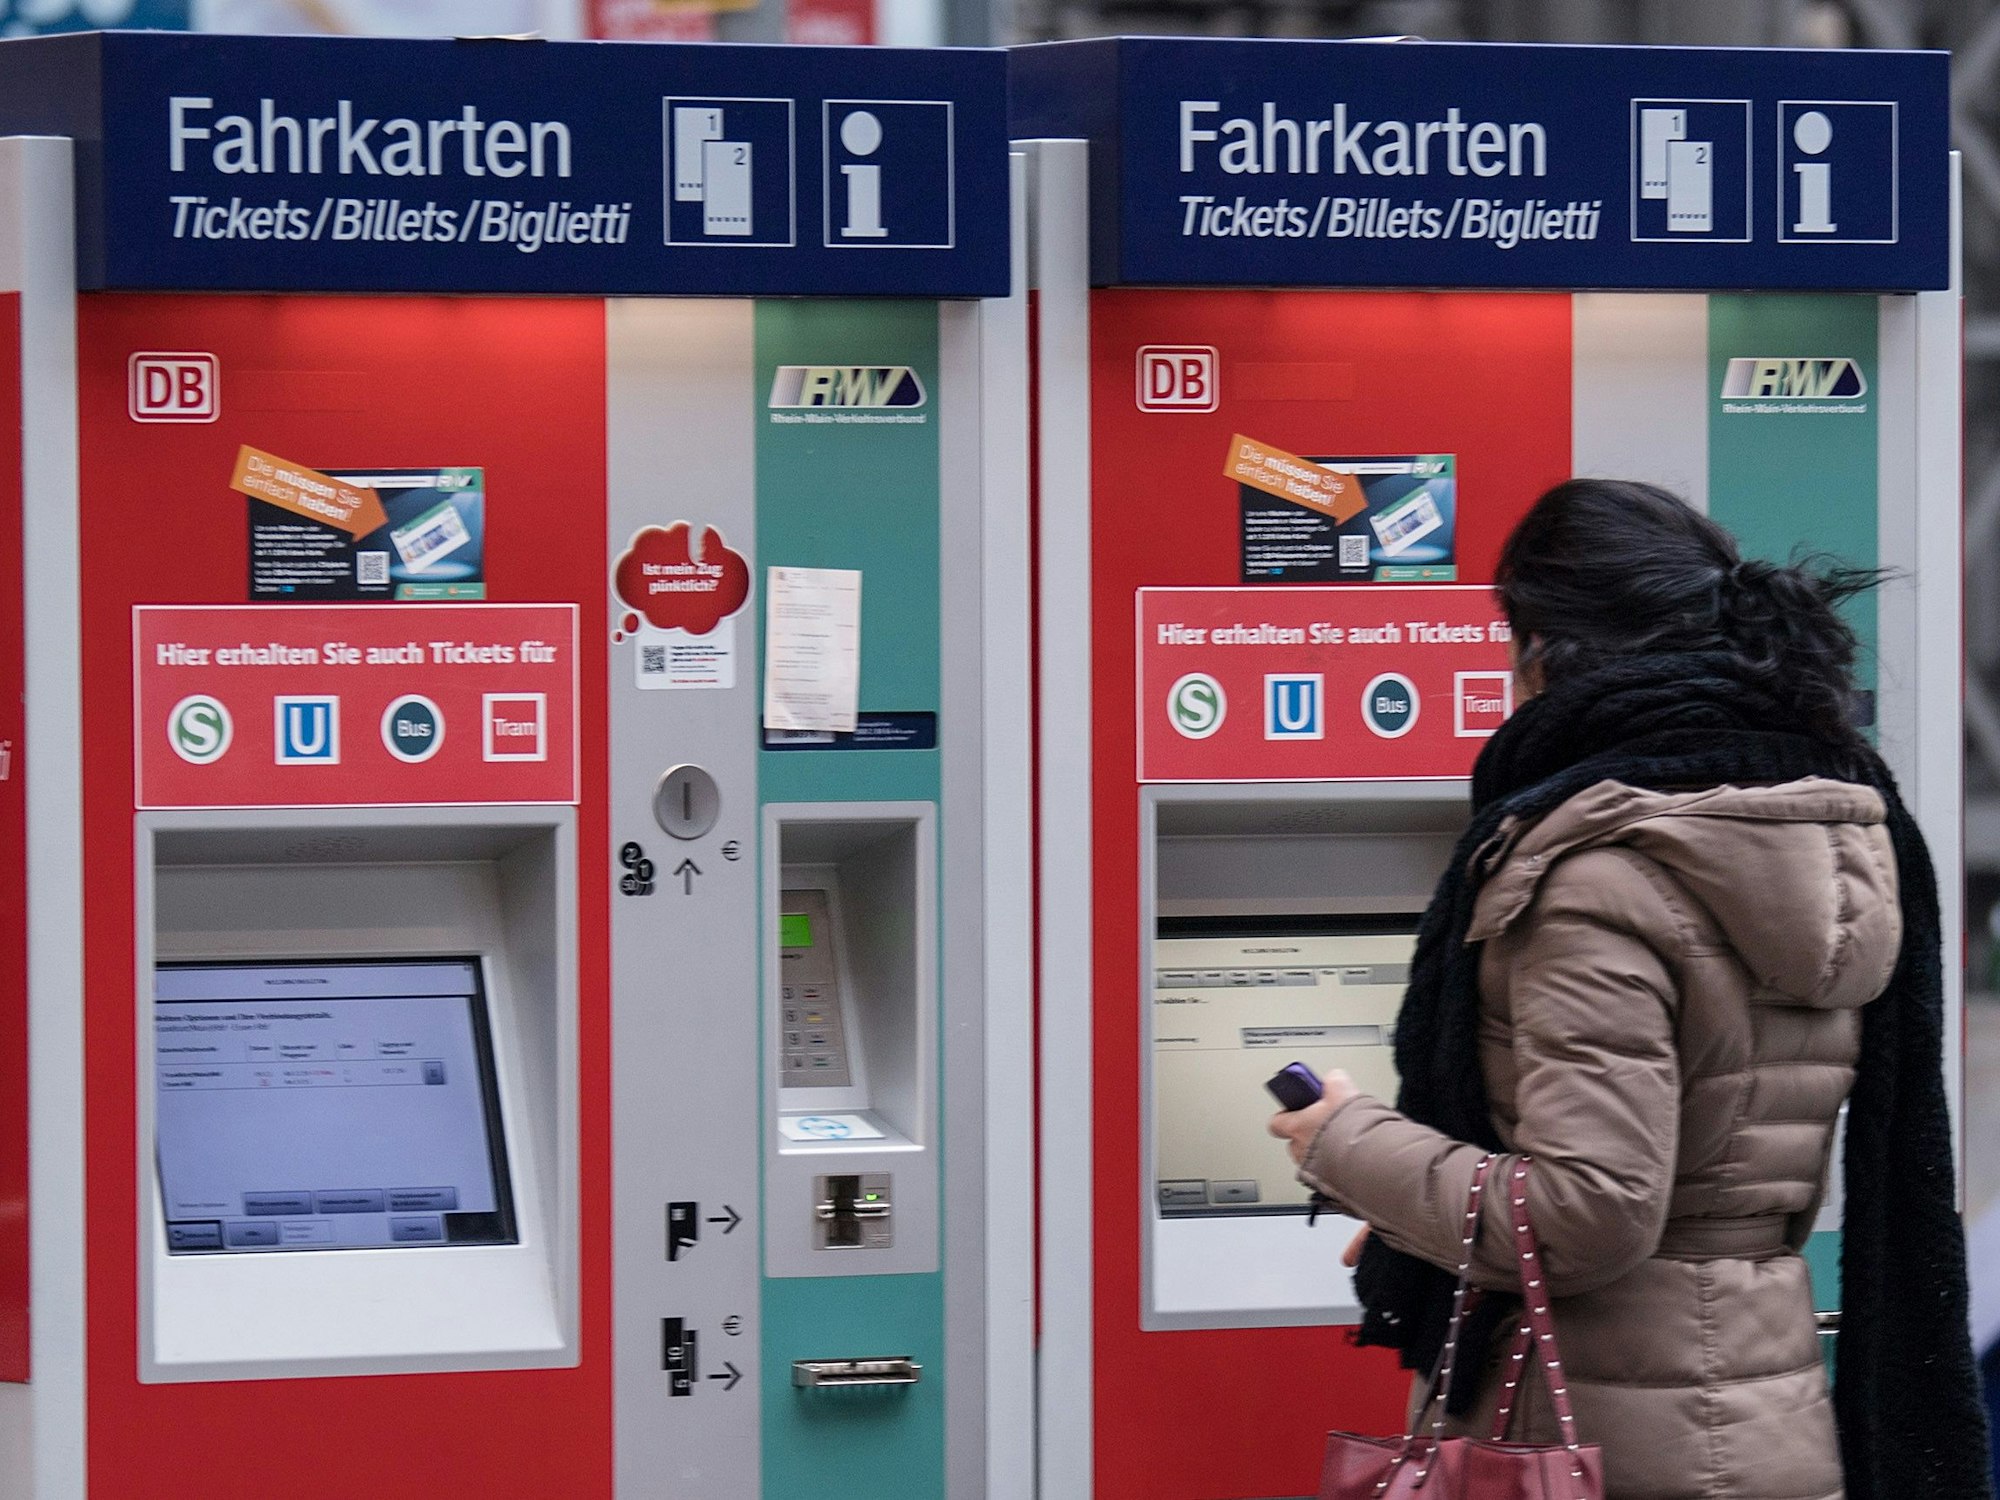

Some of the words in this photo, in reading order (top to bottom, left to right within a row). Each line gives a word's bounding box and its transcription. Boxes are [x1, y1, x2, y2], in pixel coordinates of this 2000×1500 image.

[706, 114, 717, 132] 1
[1670, 115, 1680, 132] 1
[170, 96, 571, 178] Fahrkarten
[1180, 100, 1546, 177] Fahrkarten
[733, 147, 747, 166] 2
[1695, 146, 1708, 165] 2
[170, 196, 632, 253] Tickets/Billets/Biglietti
[1180, 195, 1602, 249] Tickets/Billets/Biglietti
[144, 365, 206, 409] DB
[1150, 358, 1206, 400] DB
[247, 455, 274, 476] Die
[336, 489, 363, 508] Sie
[1239, 444, 1265, 464] Die
[1321, 475, 1345, 494] Sie
[1157, 623, 1206, 645] Hier
[1211, 622, 1305, 644] erhalten
[1308, 622, 1345, 644] Sie
[1348, 622, 1401, 644] auch
[1405, 621, 1484, 643] Tickets
[1487, 621, 1512, 643] fü
[156, 642, 210, 666] Hier
[216, 643, 318, 666] erhalten
[322, 641, 362, 665] Sie
[365, 642, 425, 665] auch
[428, 641, 516, 664] Tickets
[519, 640, 557, 663] für
[1178, 681, 1218, 731] S
[1278, 684, 1310, 731] U
[1375, 696, 1408, 715] Bus
[1463, 696, 1502, 714] Tram
[179, 705, 220, 755] S
[290, 706, 324, 755] U
[397, 719, 431, 738] Bus
[492, 718, 536, 737] Tram
[721, 840, 742, 862] €
[721, 1314, 743, 1337] €
[667, 1346, 685, 1361] 10
